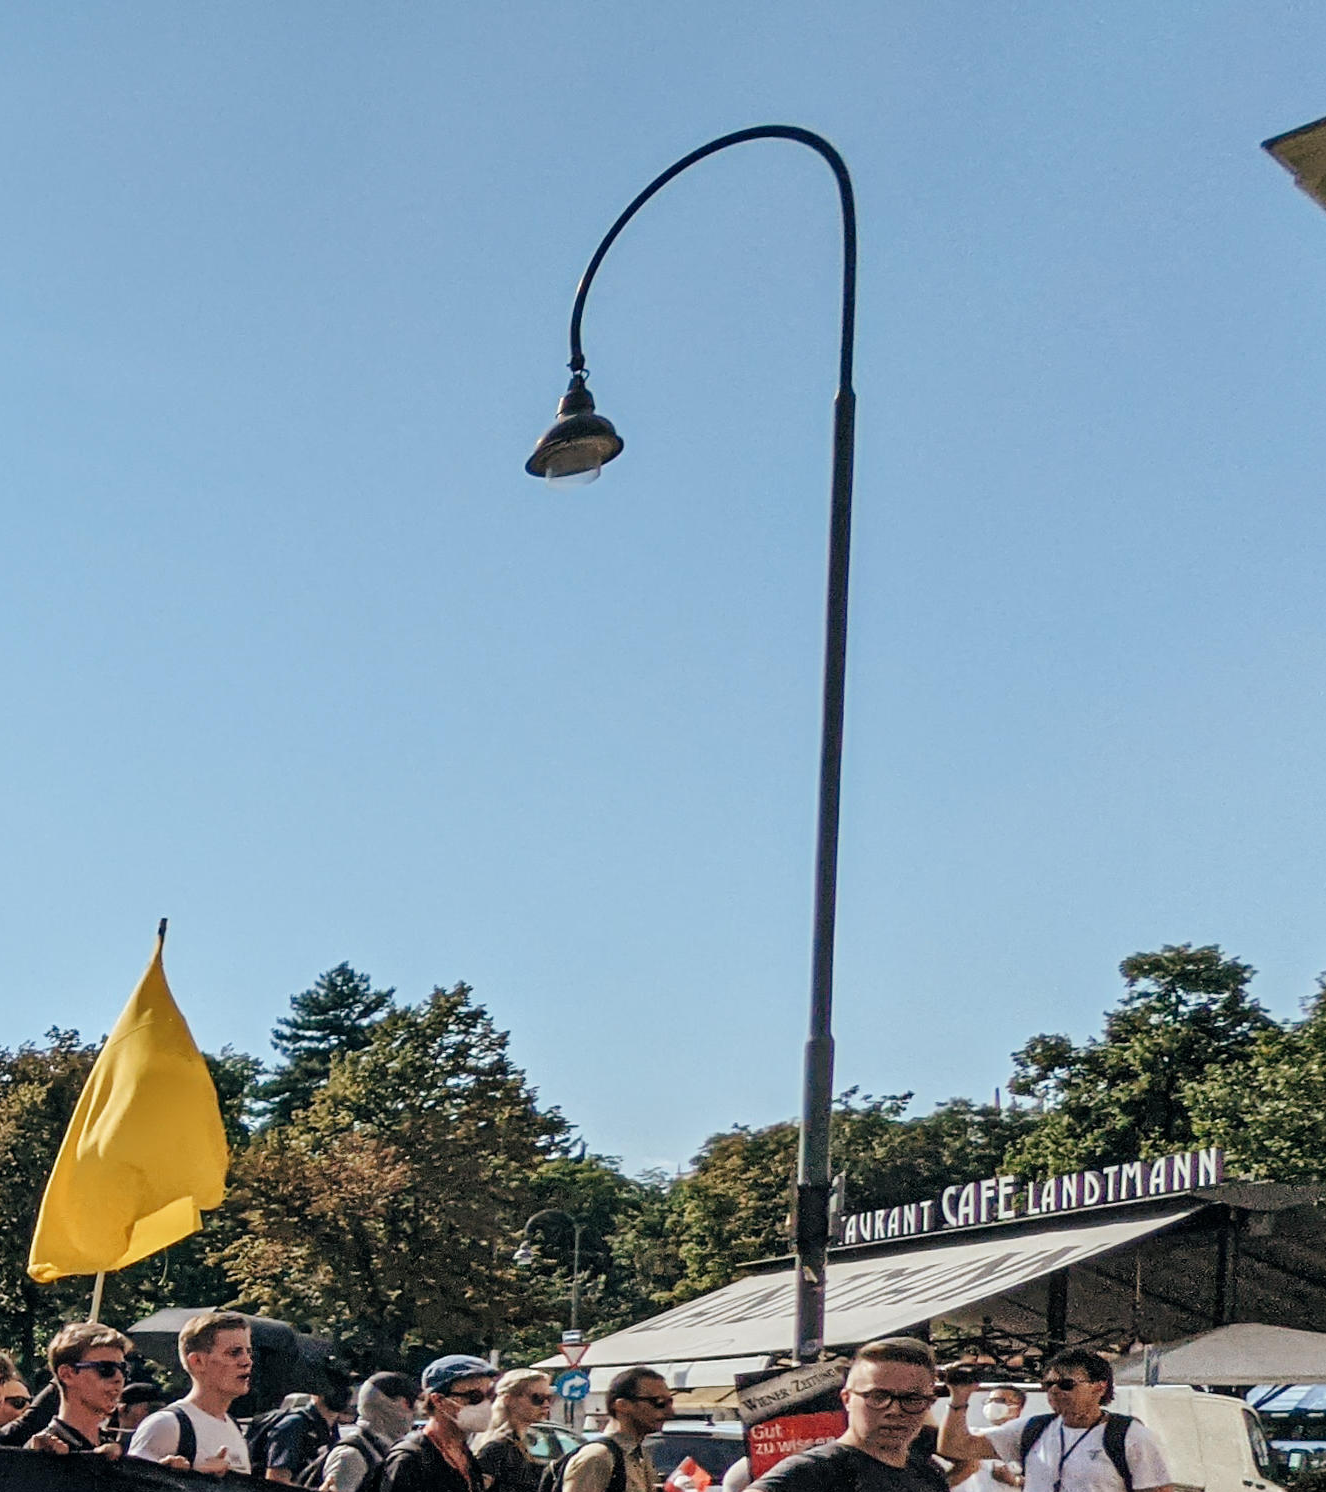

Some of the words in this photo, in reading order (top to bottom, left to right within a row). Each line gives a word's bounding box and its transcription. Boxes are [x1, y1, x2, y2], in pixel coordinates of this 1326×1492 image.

[837, 1200, 934, 1245] AURANT
[1027, 1147, 1220, 1215] LANDTMANN
[750, 1423, 783, 1440] Gut
[754, 1442, 774, 1455] zu
